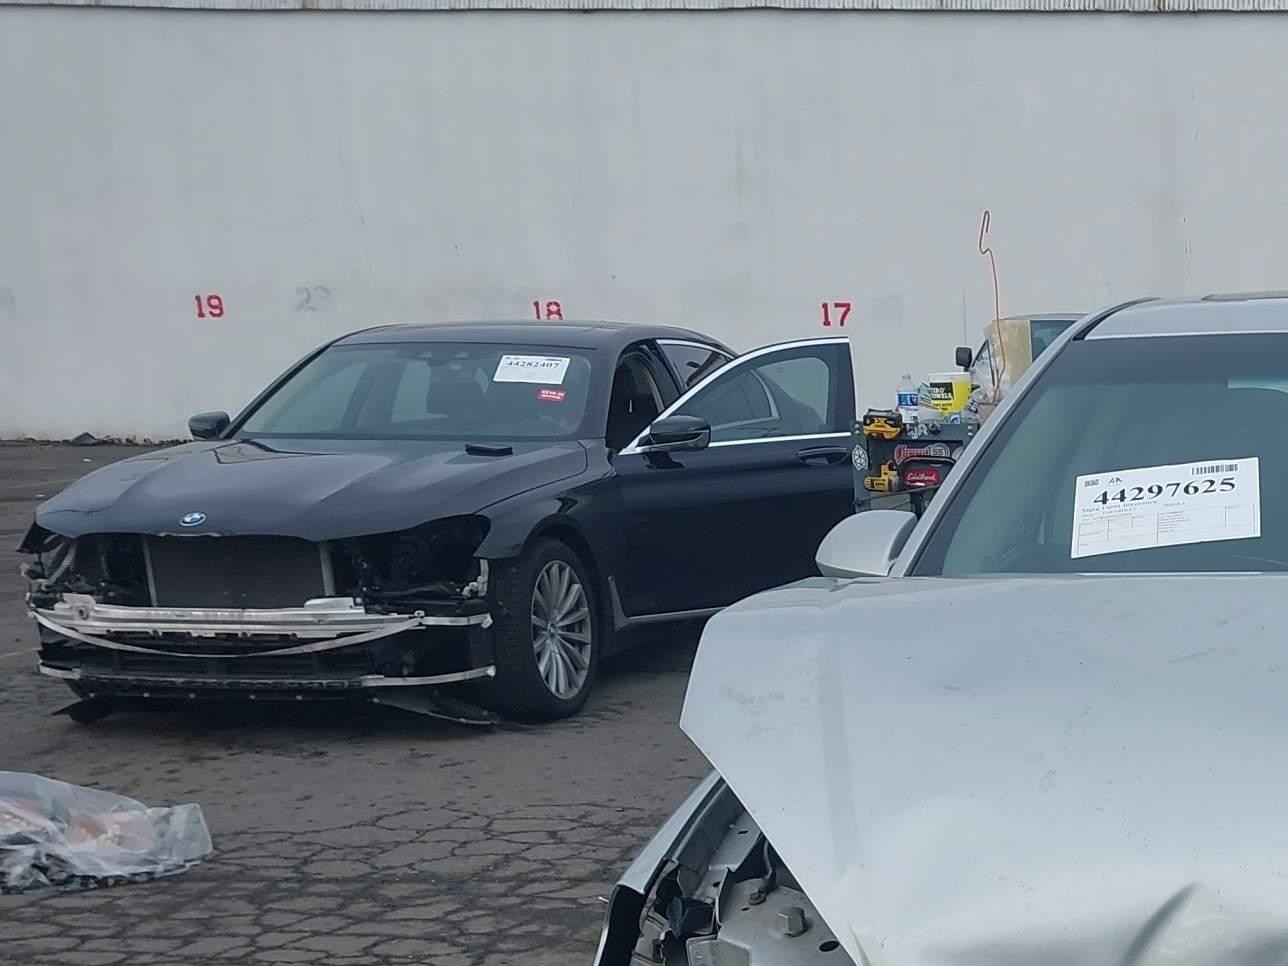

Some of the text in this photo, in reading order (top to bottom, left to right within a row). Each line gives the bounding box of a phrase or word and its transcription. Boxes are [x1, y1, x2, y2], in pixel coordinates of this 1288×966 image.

[195, 294, 224, 318] 19
[533, 300, 563, 320] 18
[821, 302, 852, 326] 17
[1093, 476, 1236, 505] 44297625
